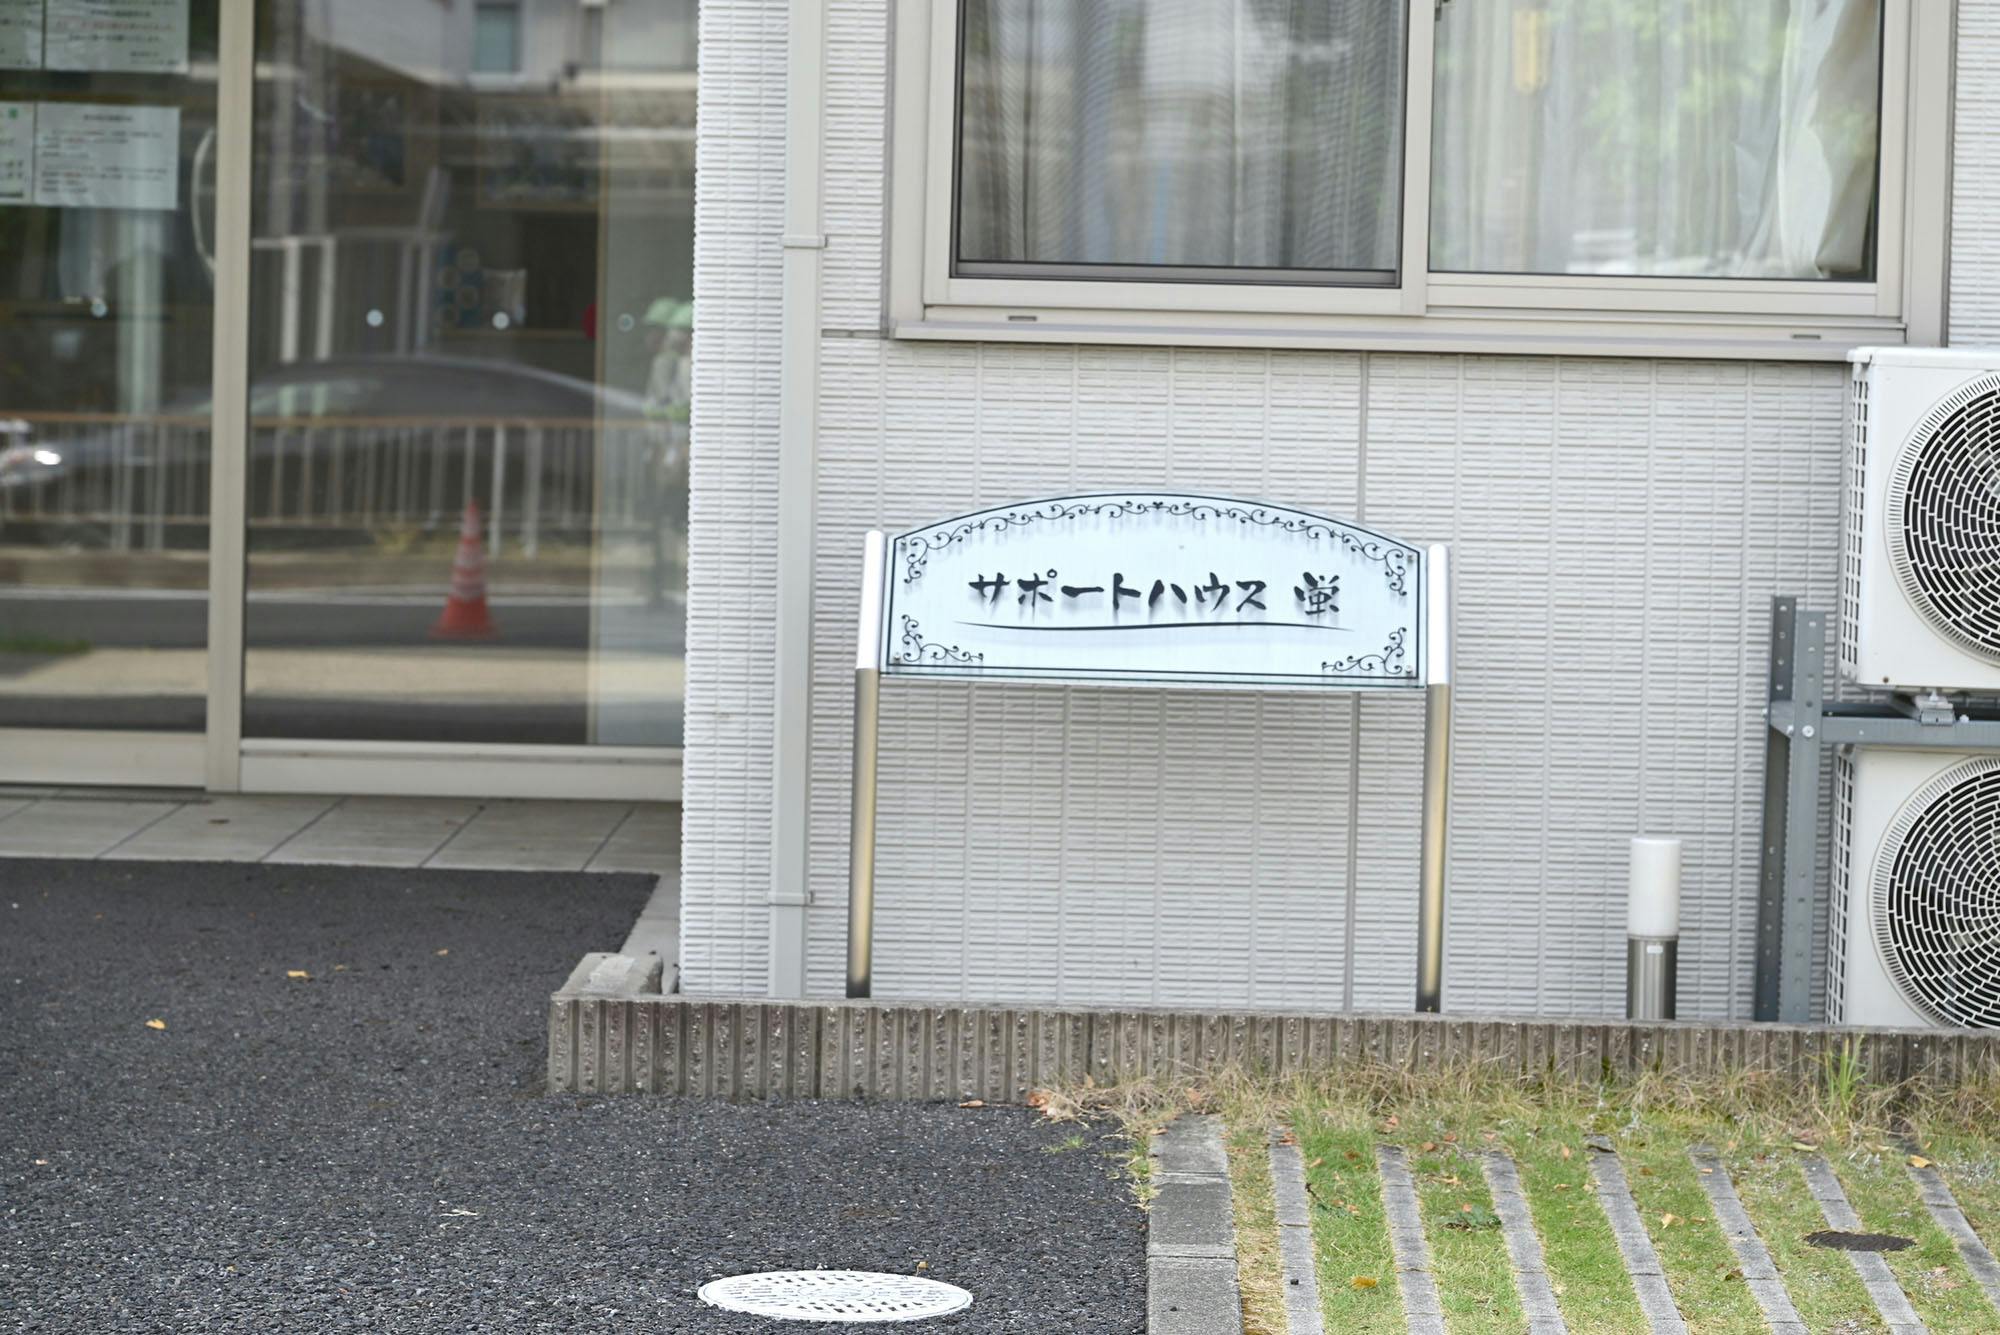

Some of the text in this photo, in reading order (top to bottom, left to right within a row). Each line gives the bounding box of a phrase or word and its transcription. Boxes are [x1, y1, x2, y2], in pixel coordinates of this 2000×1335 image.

[968, 569, 1340, 616] サポートハウス 蛍
